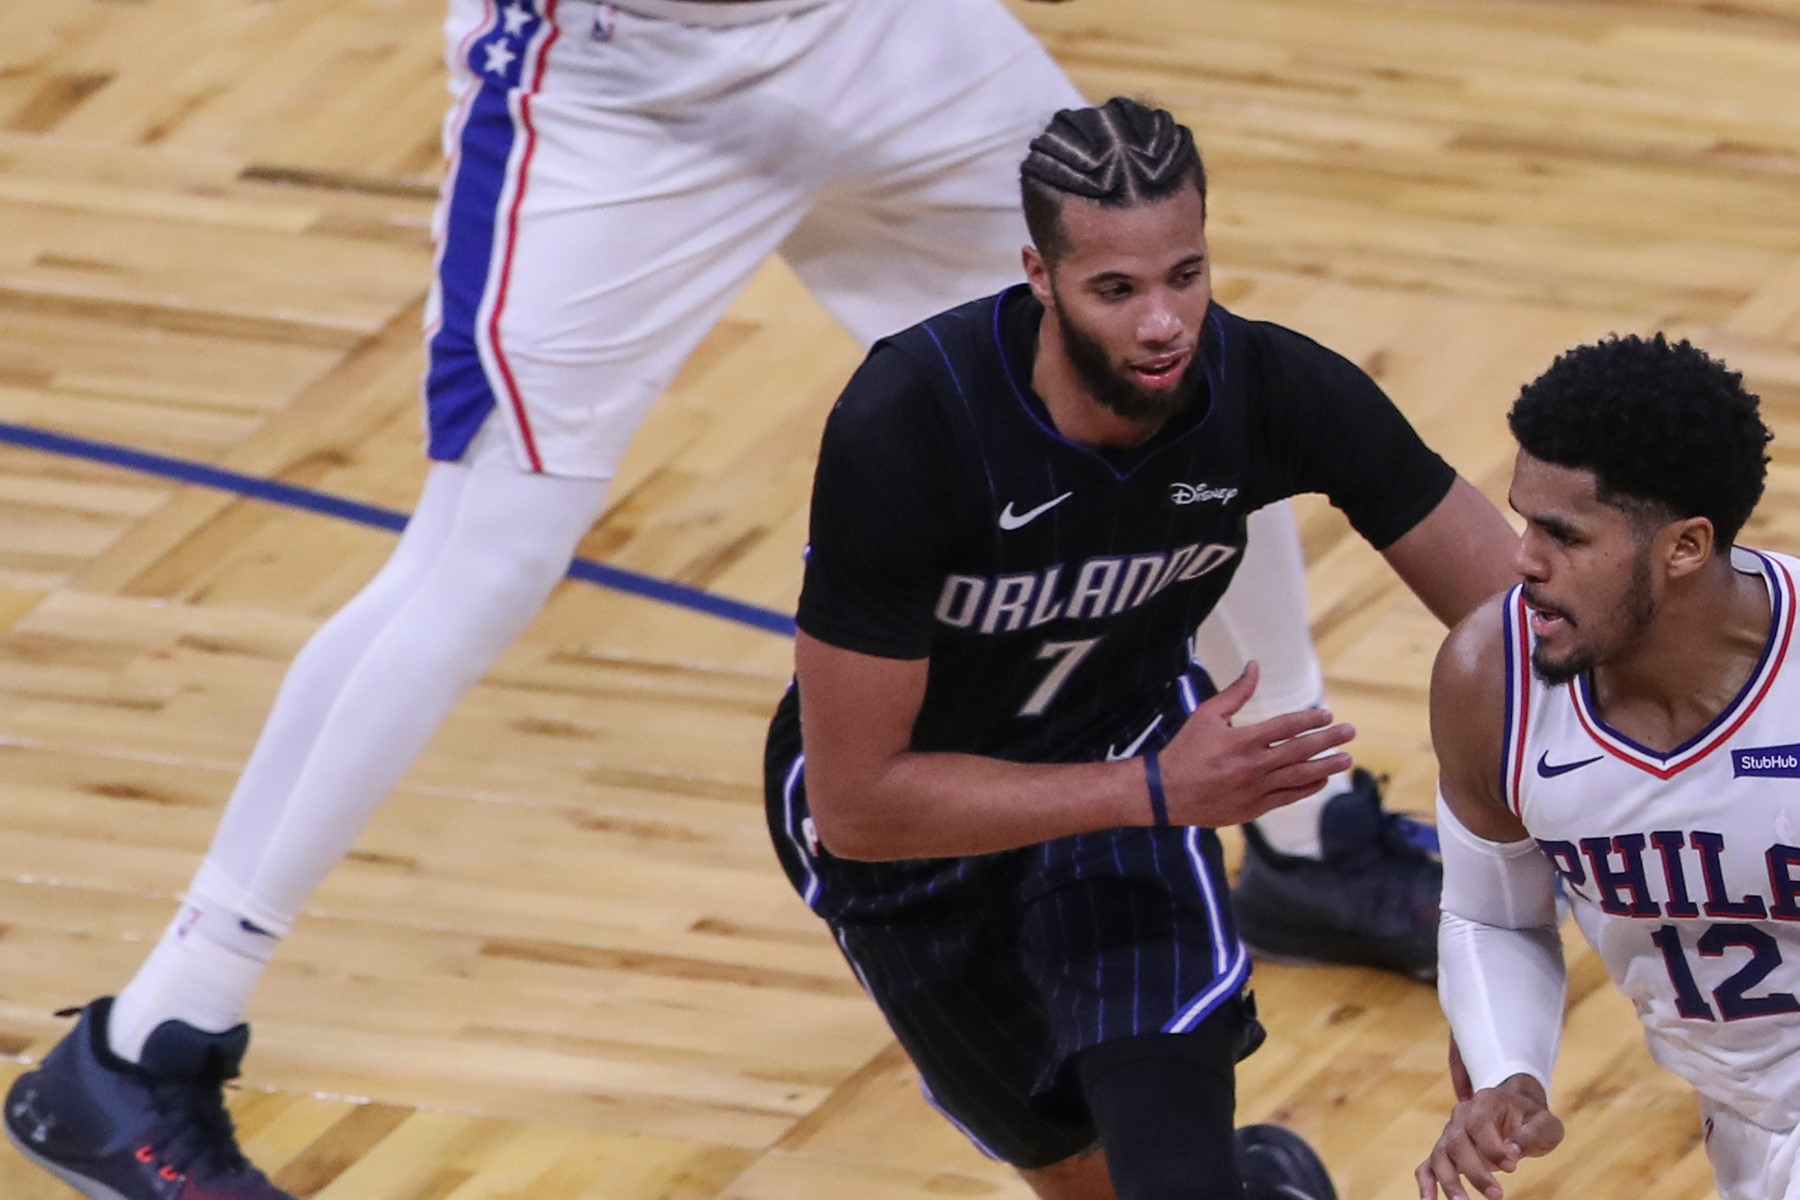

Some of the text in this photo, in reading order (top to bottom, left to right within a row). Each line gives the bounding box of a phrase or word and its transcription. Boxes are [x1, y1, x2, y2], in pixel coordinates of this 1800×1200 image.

[1169, 483, 1238, 505] Disney
[935, 543, 1237, 634] ORLANDO
[1016, 635, 1106, 717] 7
[1741, 755, 1798, 770] StubHub
